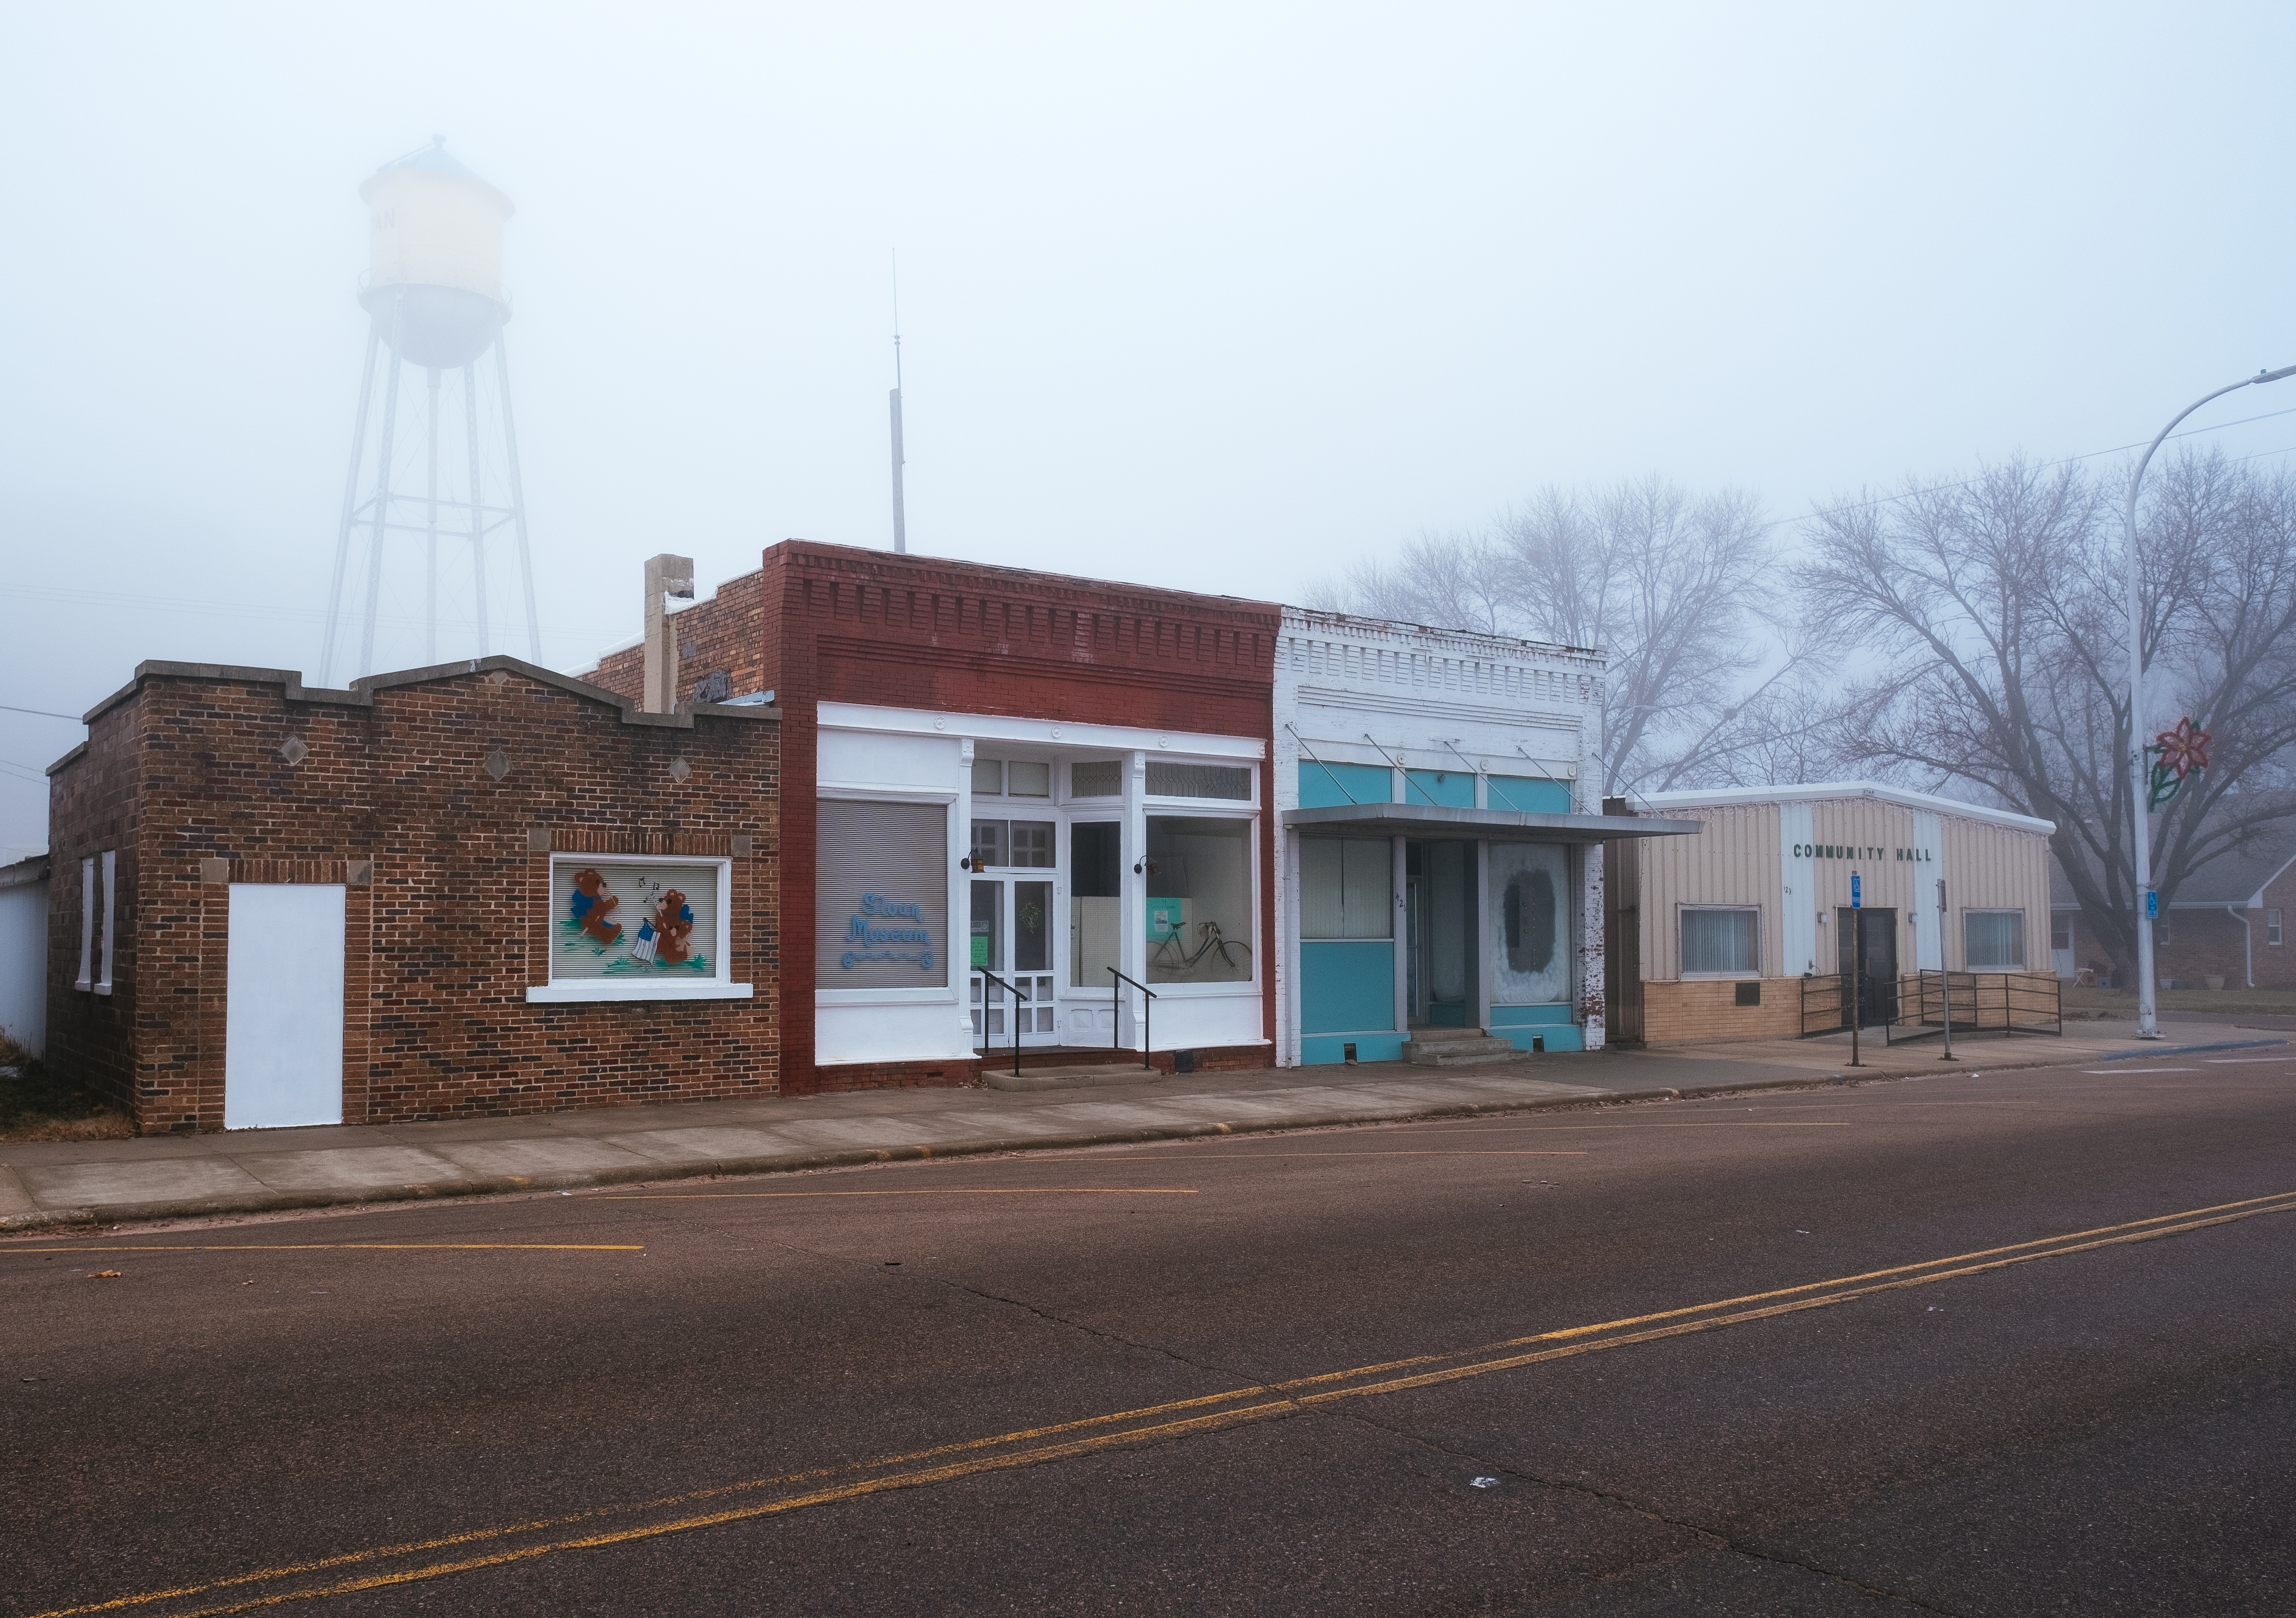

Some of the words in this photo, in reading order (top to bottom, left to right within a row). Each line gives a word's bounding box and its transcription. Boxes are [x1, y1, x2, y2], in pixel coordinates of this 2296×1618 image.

[1794, 844, 1884, 860] COMMUNITY
[1896, 848, 1931, 861] HALL
[862, 892, 925, 922] Sloan
[1396, 892, 1406, 913] 421
[845, 914, 931, 946] Museum
